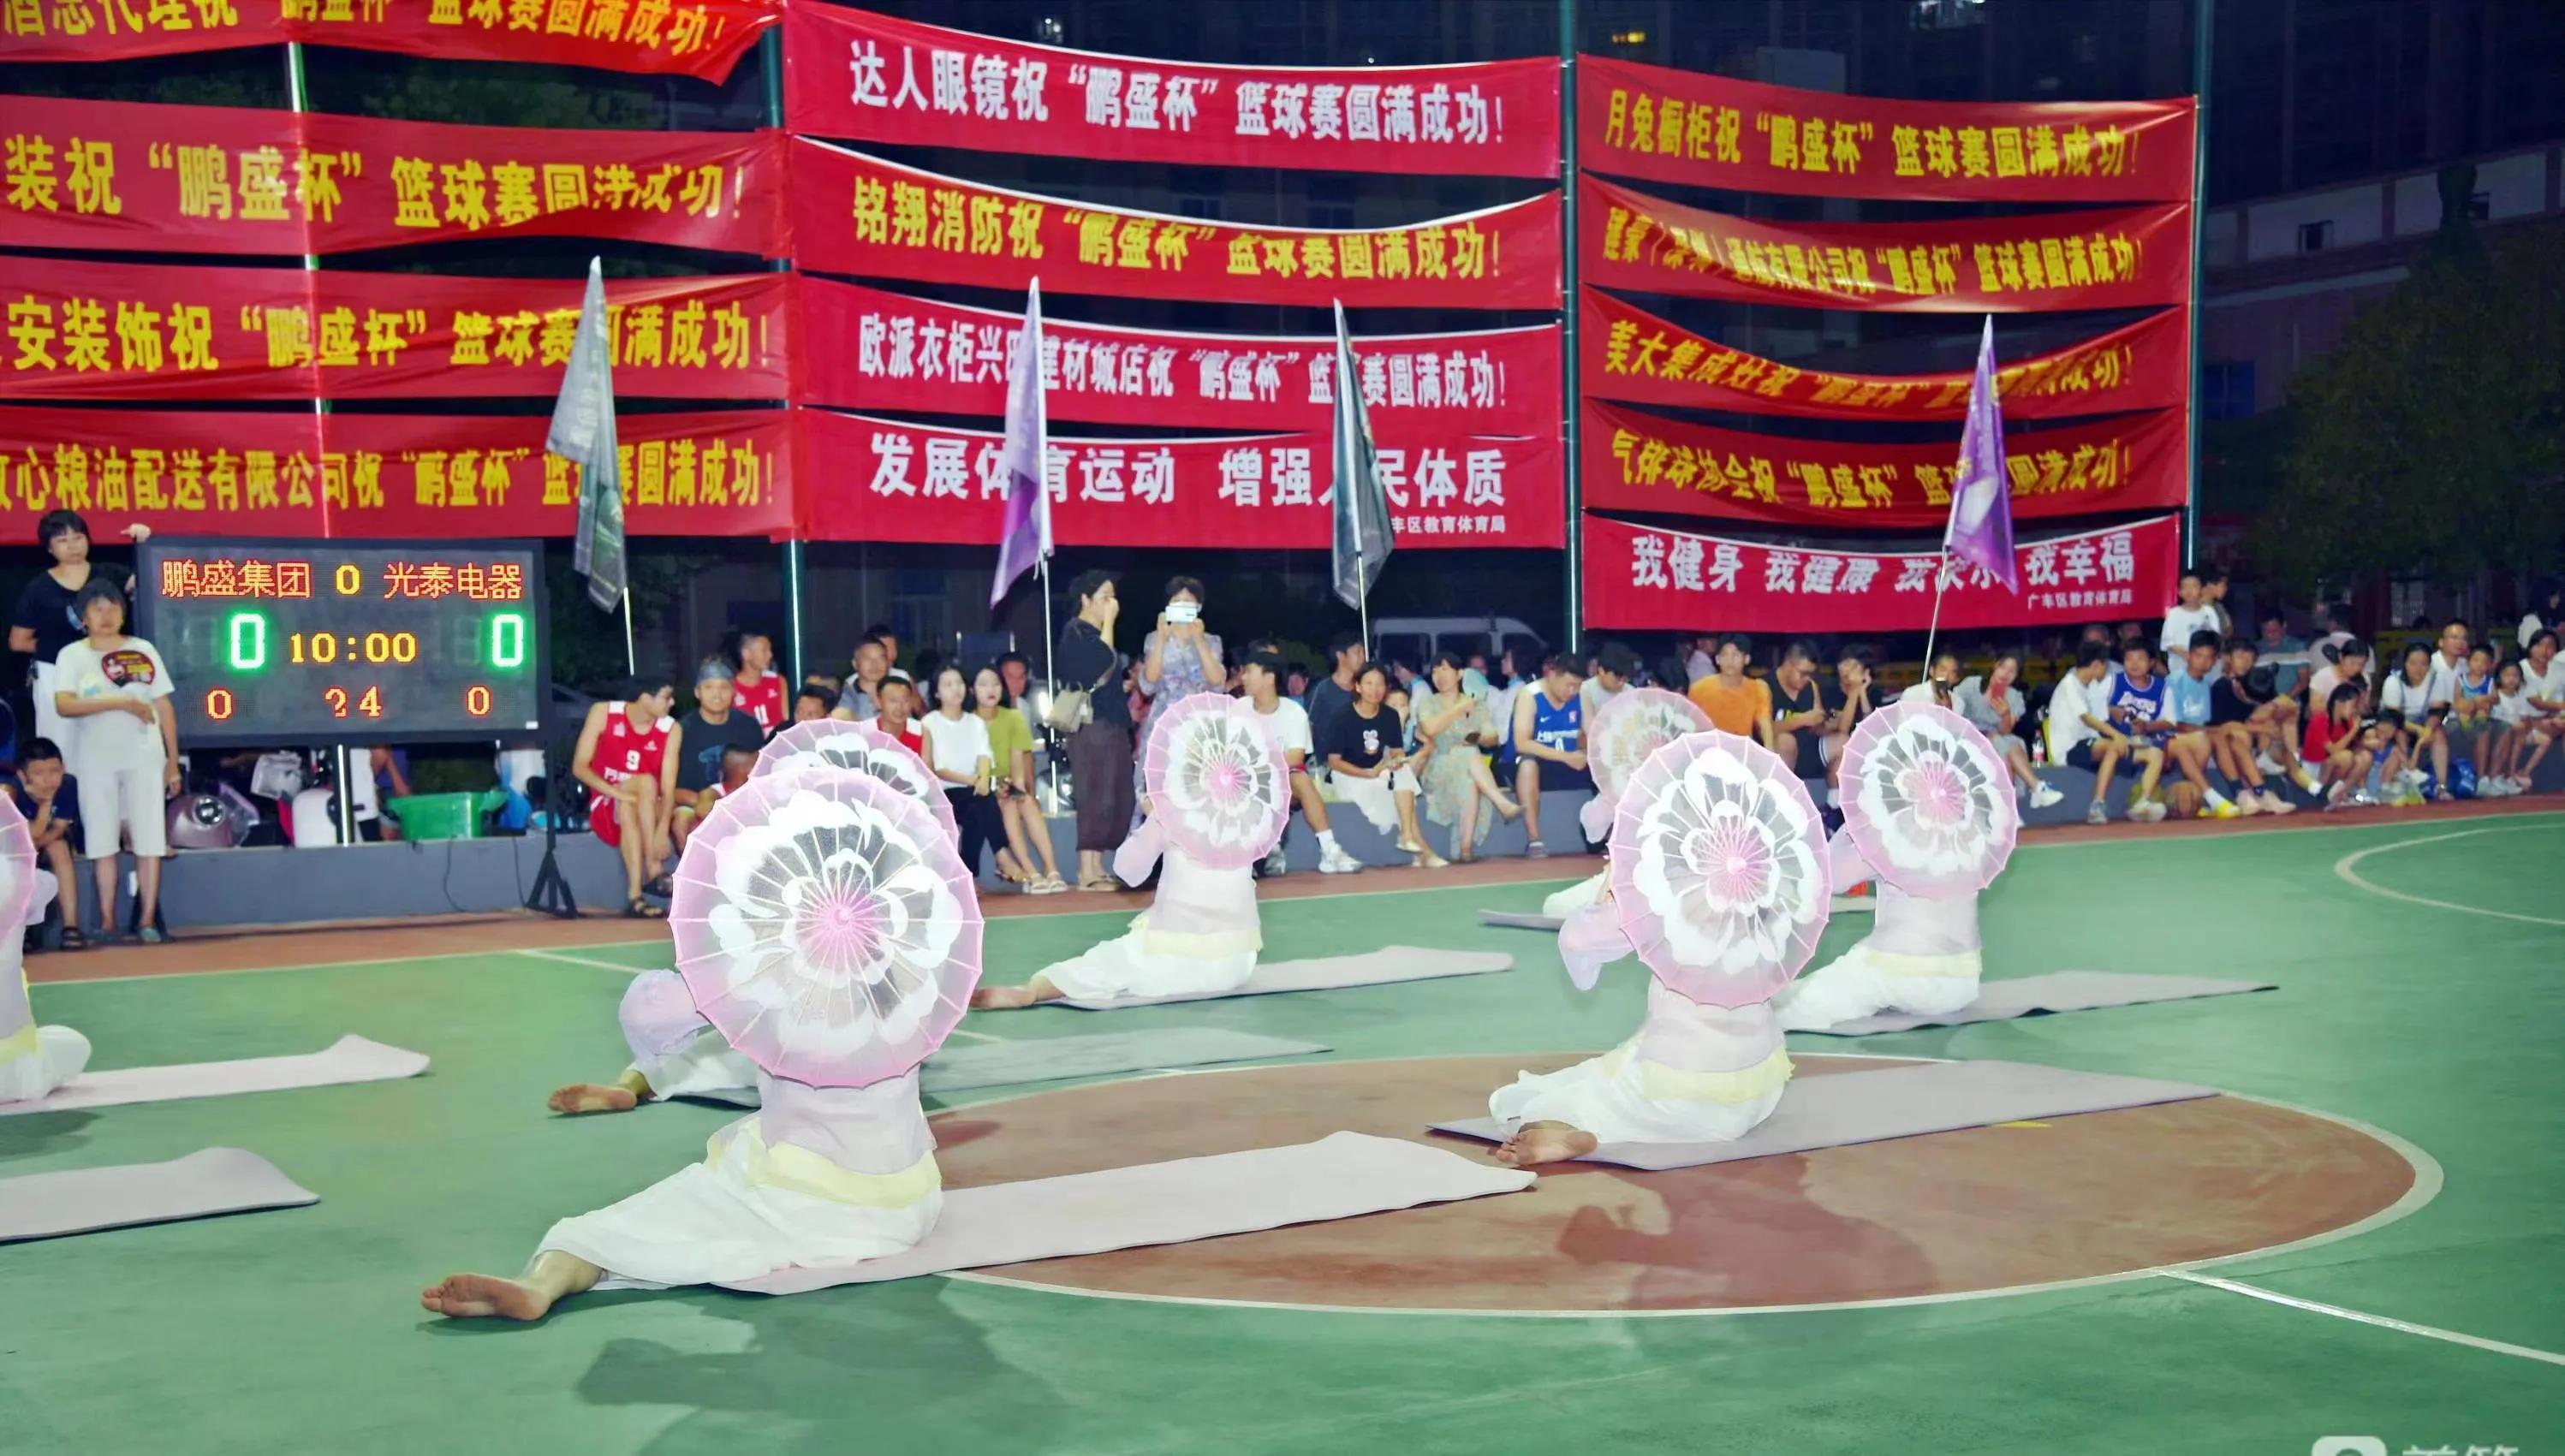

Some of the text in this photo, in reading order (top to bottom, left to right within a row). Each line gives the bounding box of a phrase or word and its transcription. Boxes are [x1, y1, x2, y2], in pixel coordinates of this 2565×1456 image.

[859, 312, 1507, 408] 欧派衣柜兴建材城店祝“鹏盛杯”篮赛圆满成功！
[869, 432, 1506, 508] 发展体育运动 增强民体质
[161, 559, 522, 600] 鹏盛集团 0 光泰电器
[1631, 534, 1743, 592] 我健身
[1765, 550, 1881, 594] 我健康
[2025, 531, 2134, 585] 我幸福
[230, 612, 525, 670] 0 10:00 0
[205, 688, 234, 721] 0
[466, 685, 491, 716] 0
